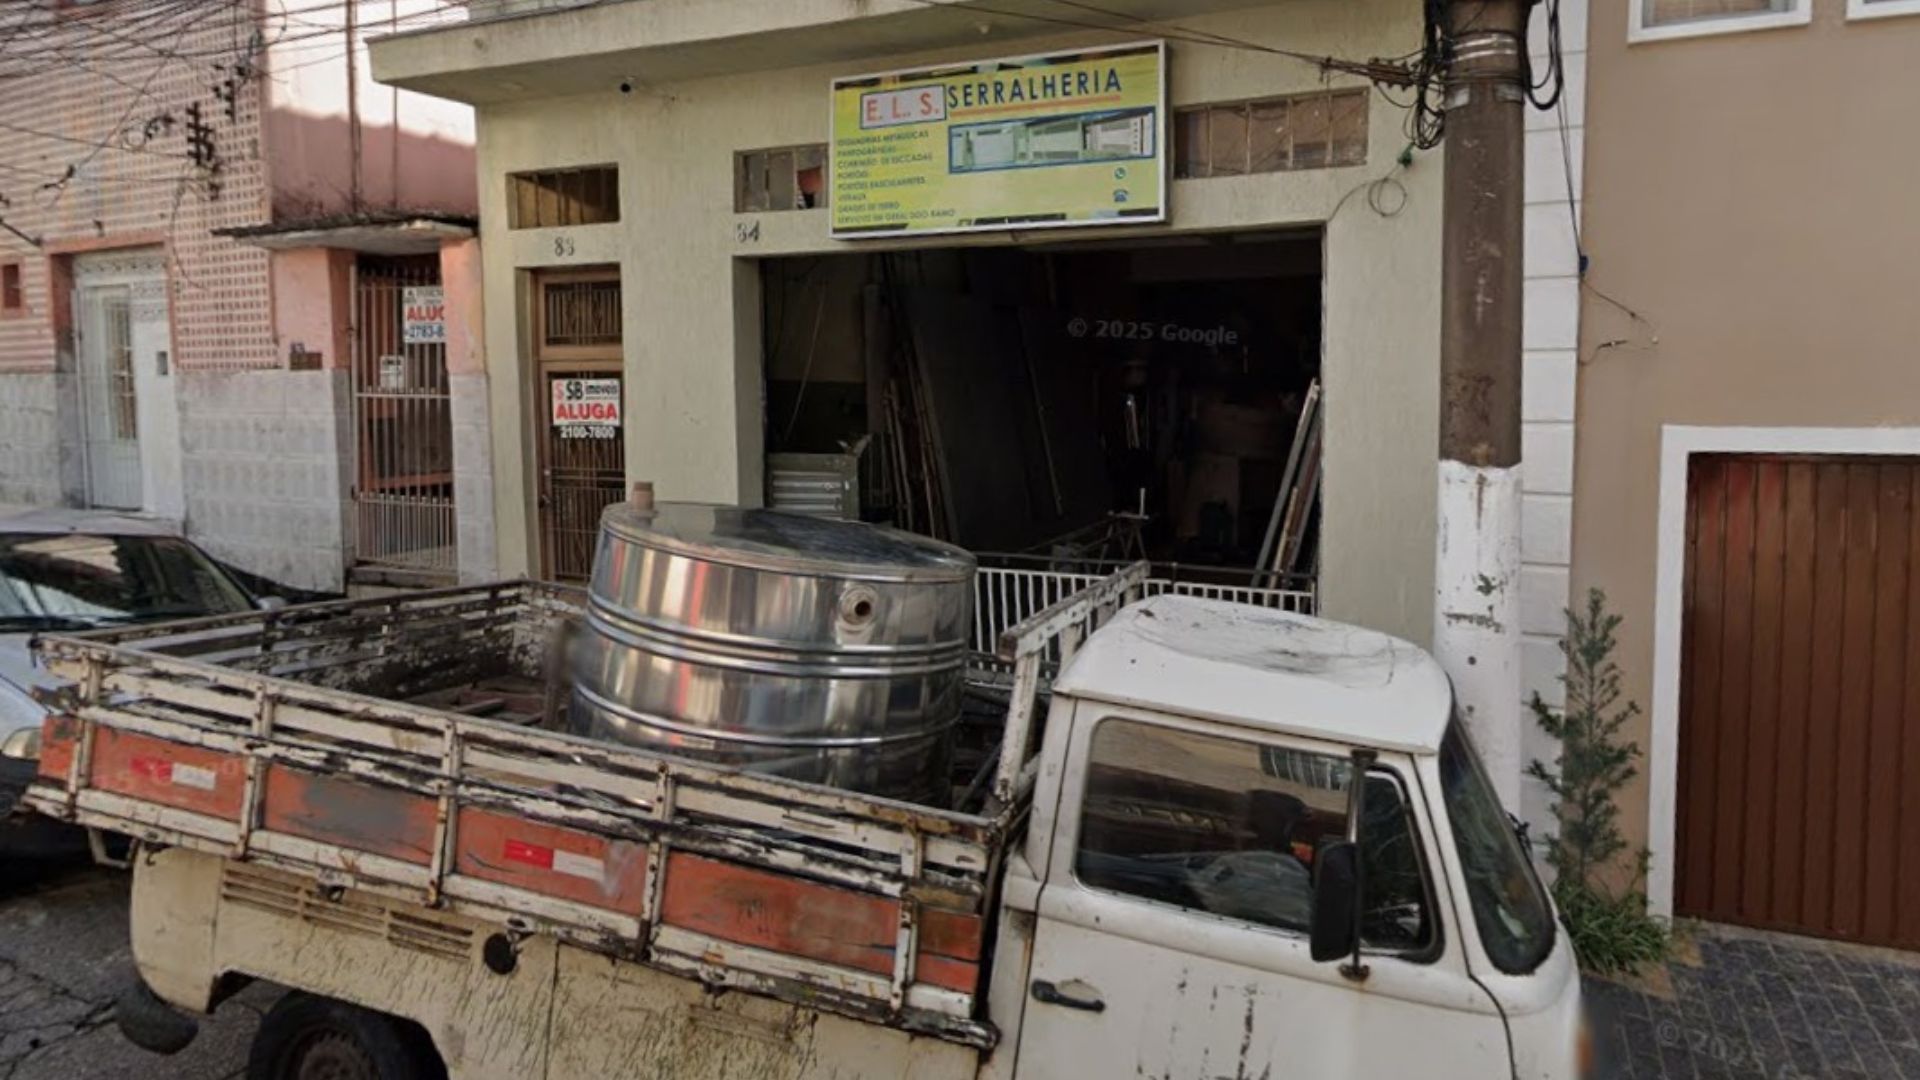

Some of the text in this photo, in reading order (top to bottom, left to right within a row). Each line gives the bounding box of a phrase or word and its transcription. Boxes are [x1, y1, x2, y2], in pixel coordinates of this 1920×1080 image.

[948, 68, 1122, 109] SERRALHERIA
[566, 381, 583, 400] SB
[556, 402, 617, 420] ALUGA
